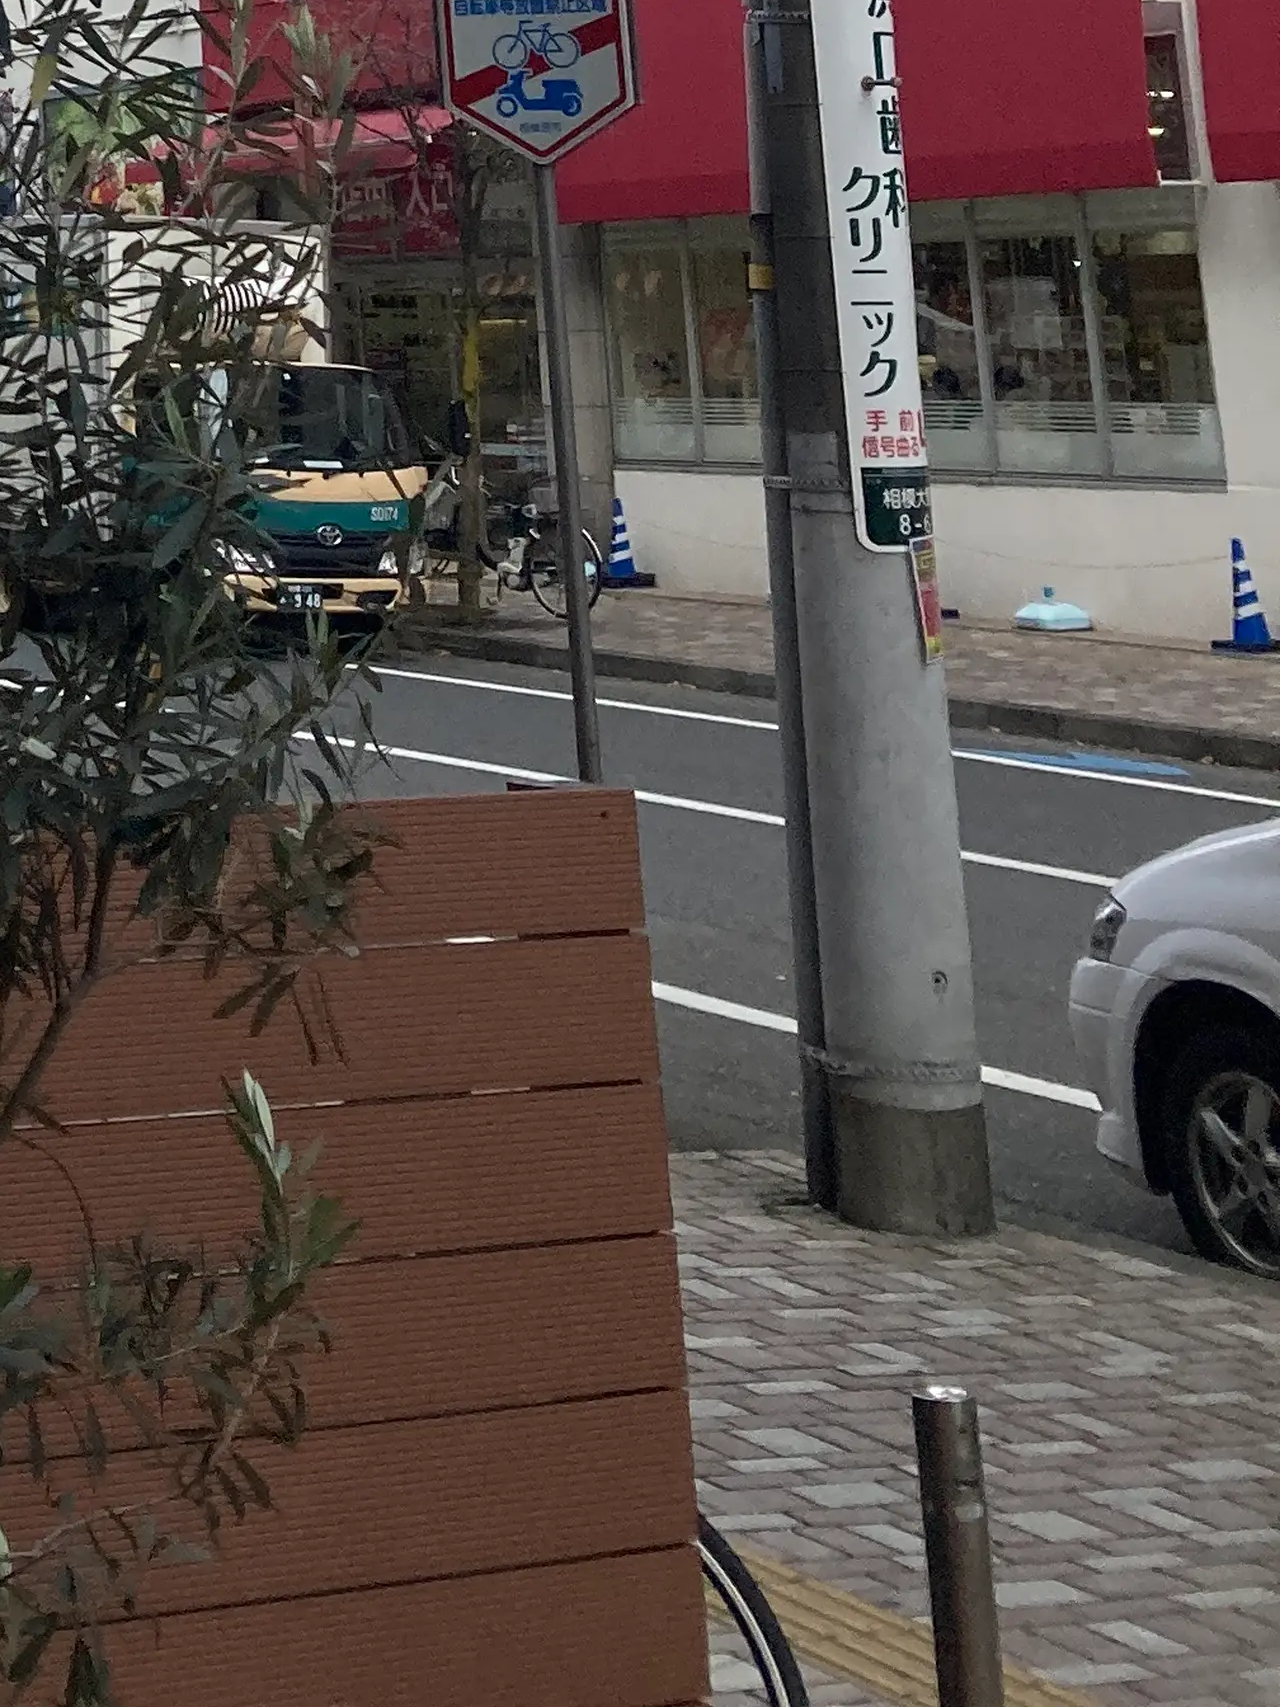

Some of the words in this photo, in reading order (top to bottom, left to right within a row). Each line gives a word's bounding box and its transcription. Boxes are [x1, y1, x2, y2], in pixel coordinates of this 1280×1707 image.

[842, 166, 898, 398] クリニック
